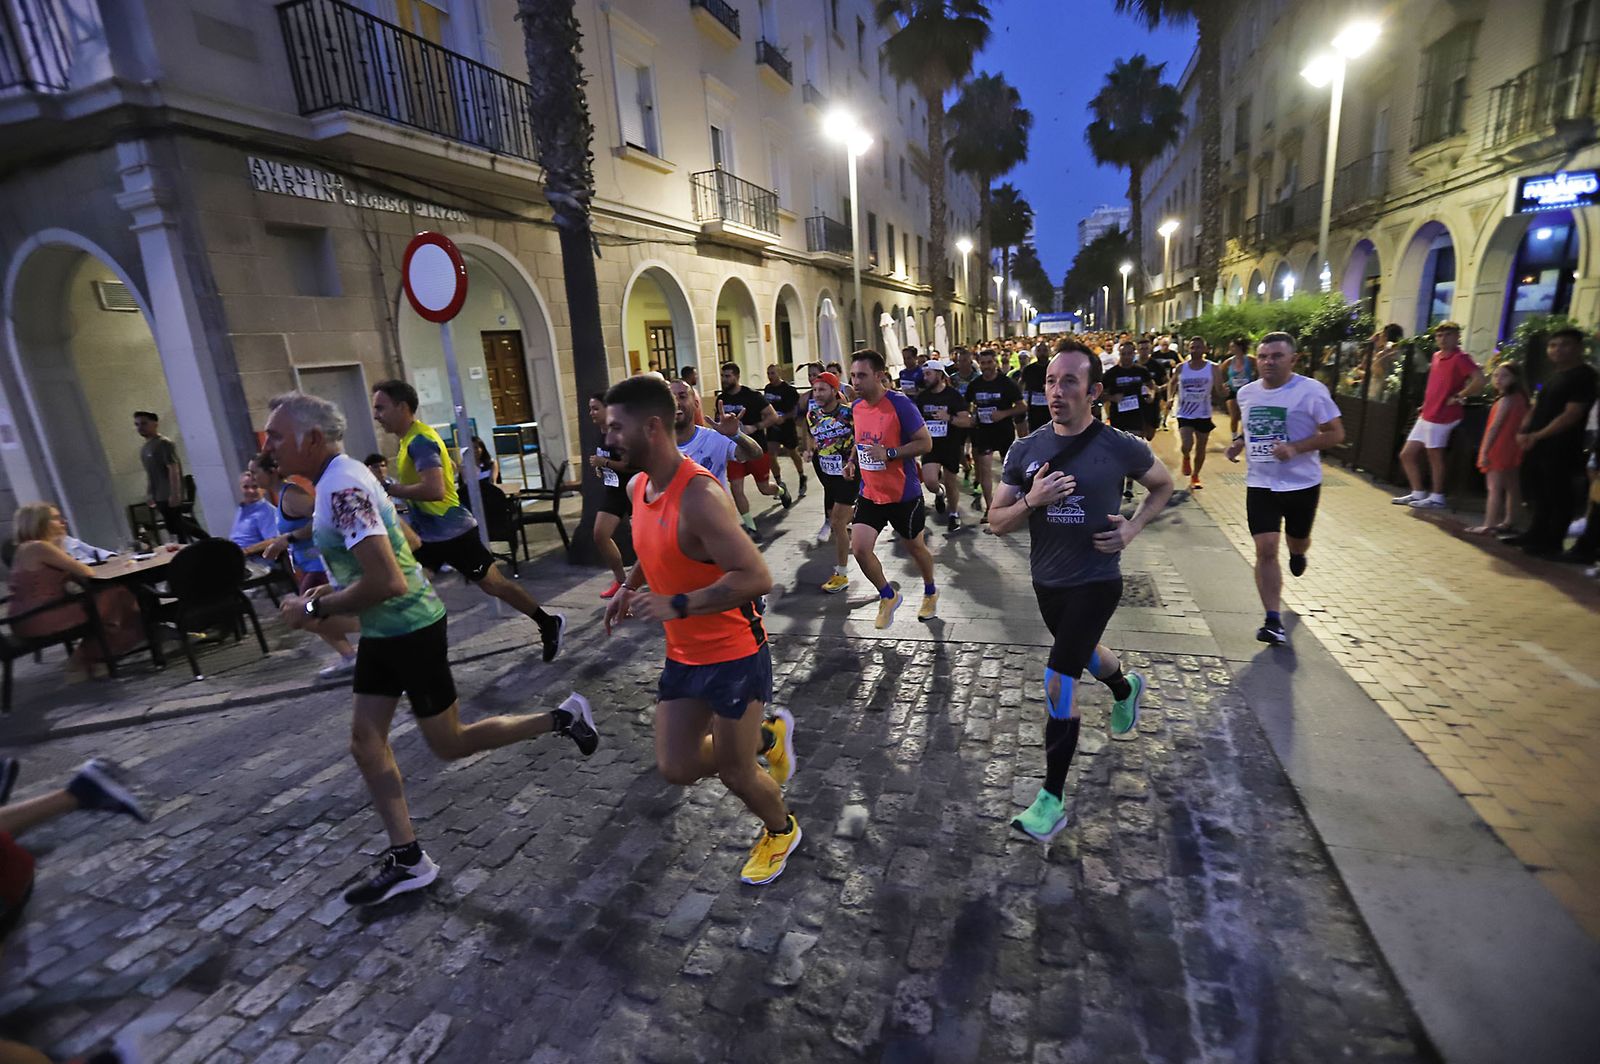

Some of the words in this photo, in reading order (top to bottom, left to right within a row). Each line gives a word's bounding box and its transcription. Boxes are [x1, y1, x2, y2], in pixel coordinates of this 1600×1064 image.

[252, 158, 344, 188] AVENIDA
[810, 420, 845, 435] UELVA
[815, 426, 852, 441] NNERS
[1047, 516, 1085, 524] GENERALI
